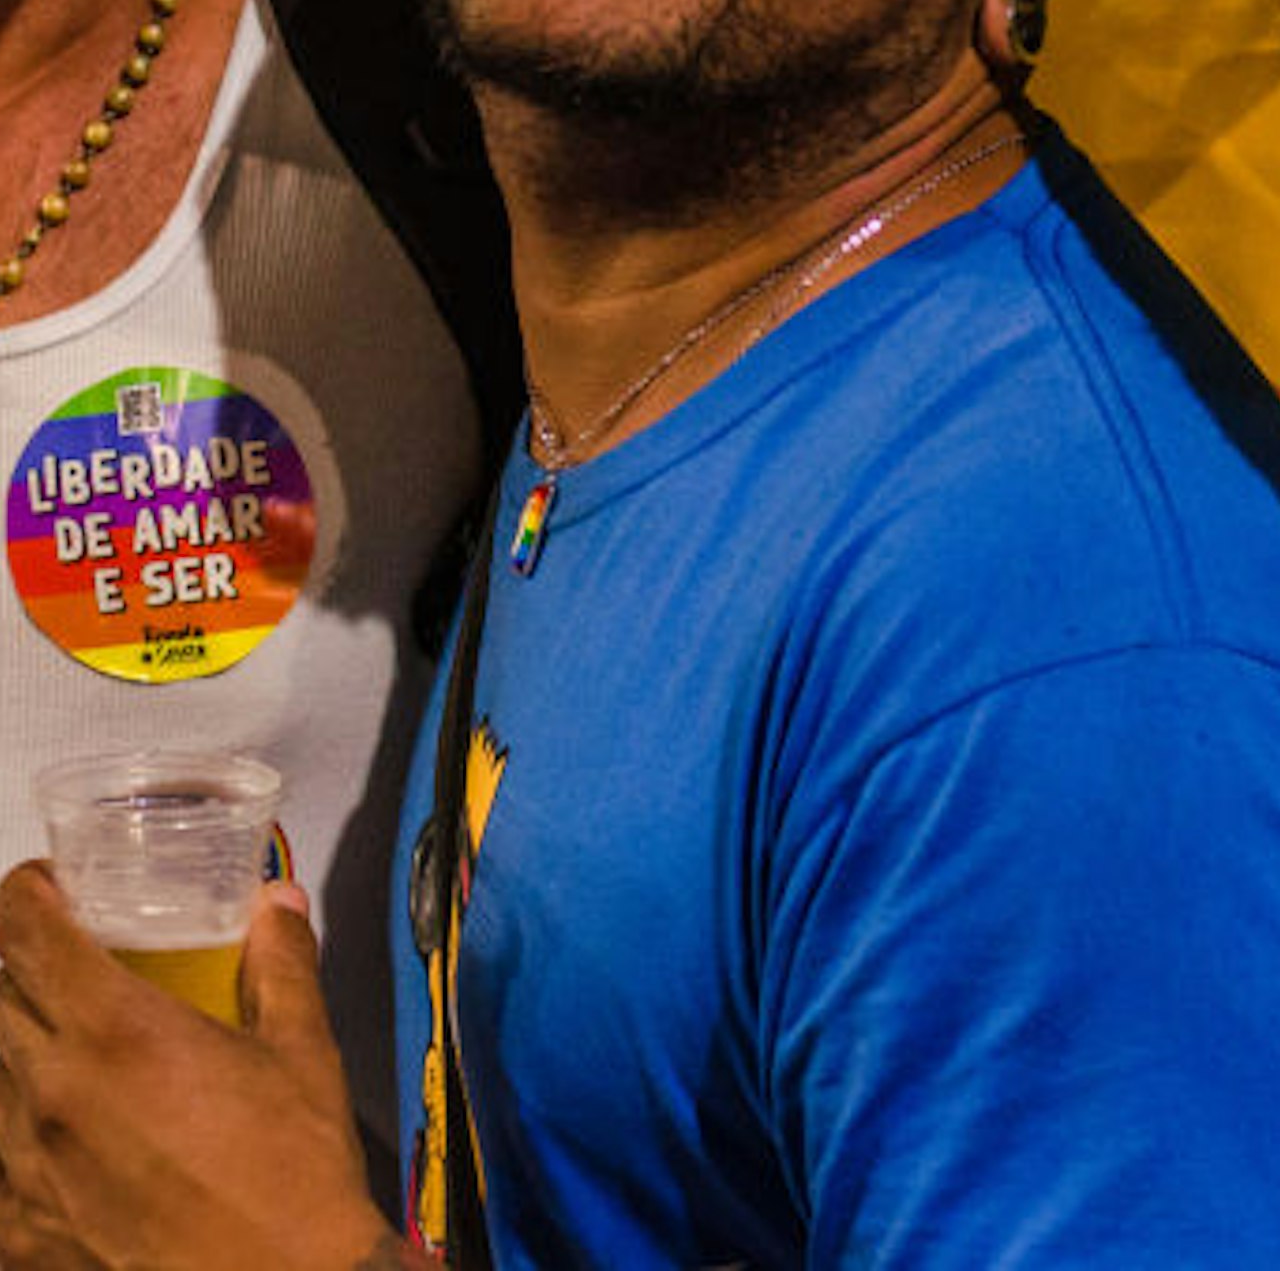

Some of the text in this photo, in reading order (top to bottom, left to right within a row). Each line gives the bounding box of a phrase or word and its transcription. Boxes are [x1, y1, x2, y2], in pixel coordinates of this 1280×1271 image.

[27, 437, 270, 513] LIBERDADE
[55, 494, 264, 561] DE AMAR
[96, 554, 237, 614] E SER
